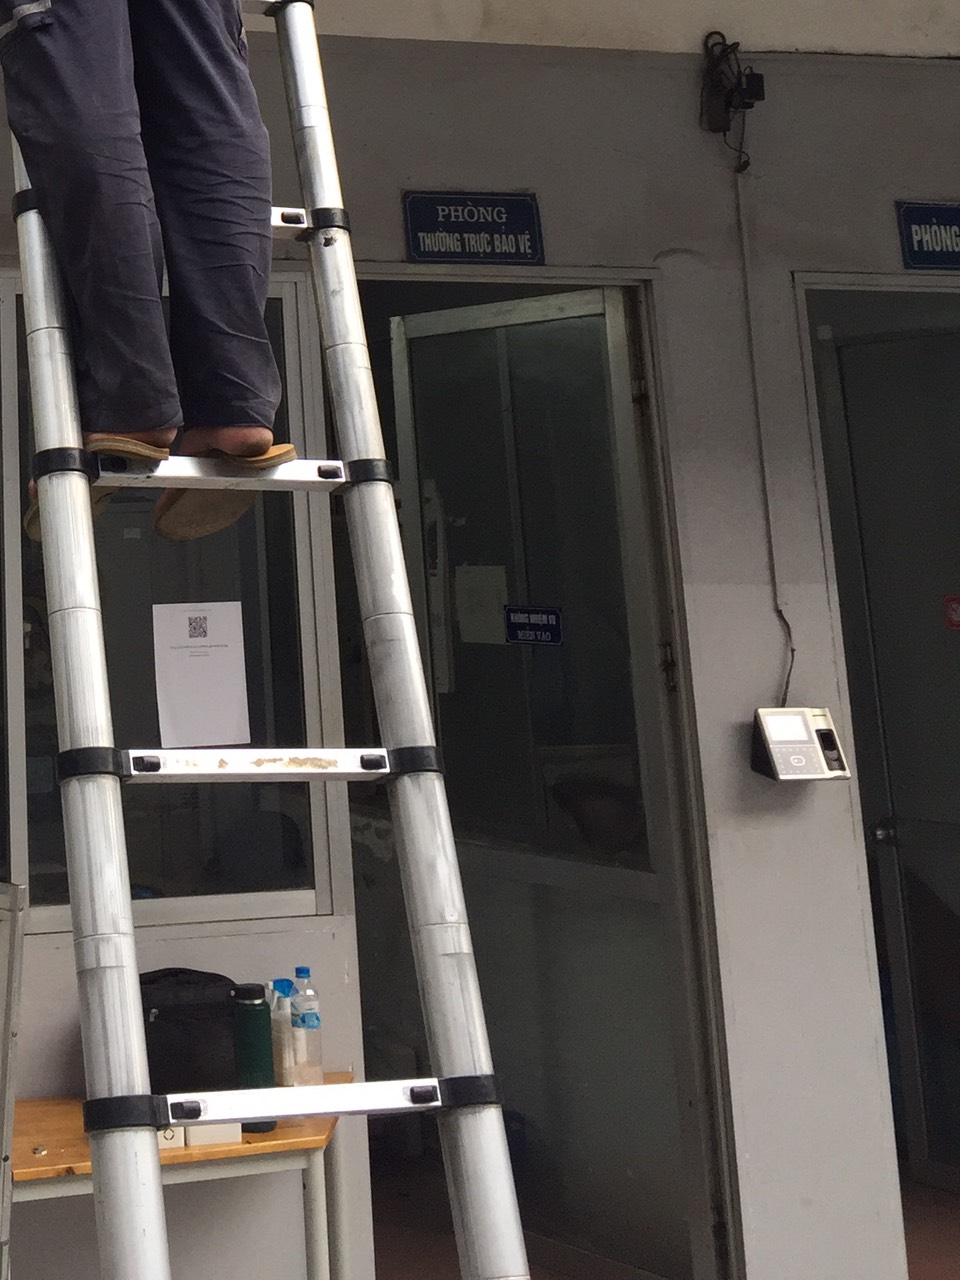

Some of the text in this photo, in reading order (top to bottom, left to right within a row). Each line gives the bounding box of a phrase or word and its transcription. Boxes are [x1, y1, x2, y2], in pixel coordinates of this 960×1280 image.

[436, 201, 508, 222] PHÒNG
[418, 225, 533, 258] THƯỜNG TRỰC BẢO VỆ
[911, 217, 960, 252] PHÒNG
